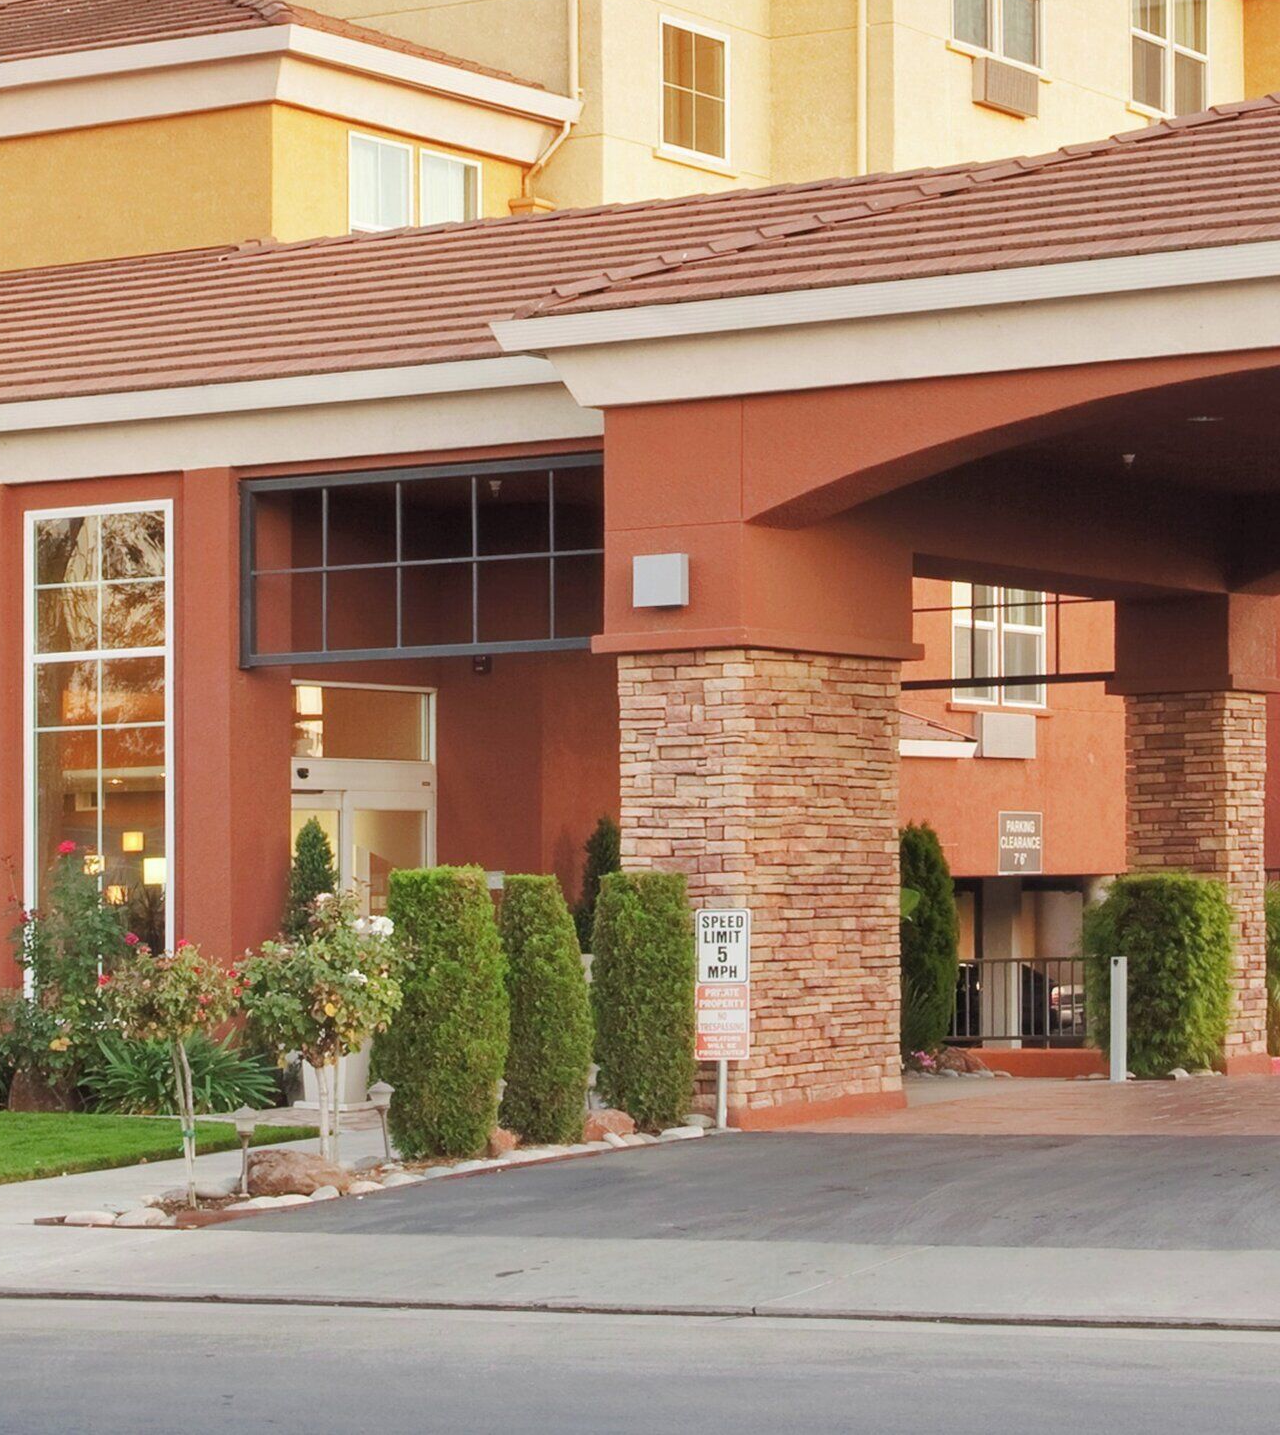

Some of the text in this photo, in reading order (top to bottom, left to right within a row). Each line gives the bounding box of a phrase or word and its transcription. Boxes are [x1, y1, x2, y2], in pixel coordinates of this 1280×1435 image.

[1006, 820, 1035, 833] PARKING
[1001, 836, 1040, 849] CLEARANCE
[702, 915, 744, 928] SPEED
[704, 930, 741, 944] LIMIT
[717, 946, 728, 963] 5
[707, 965, 737, 979] MPH
